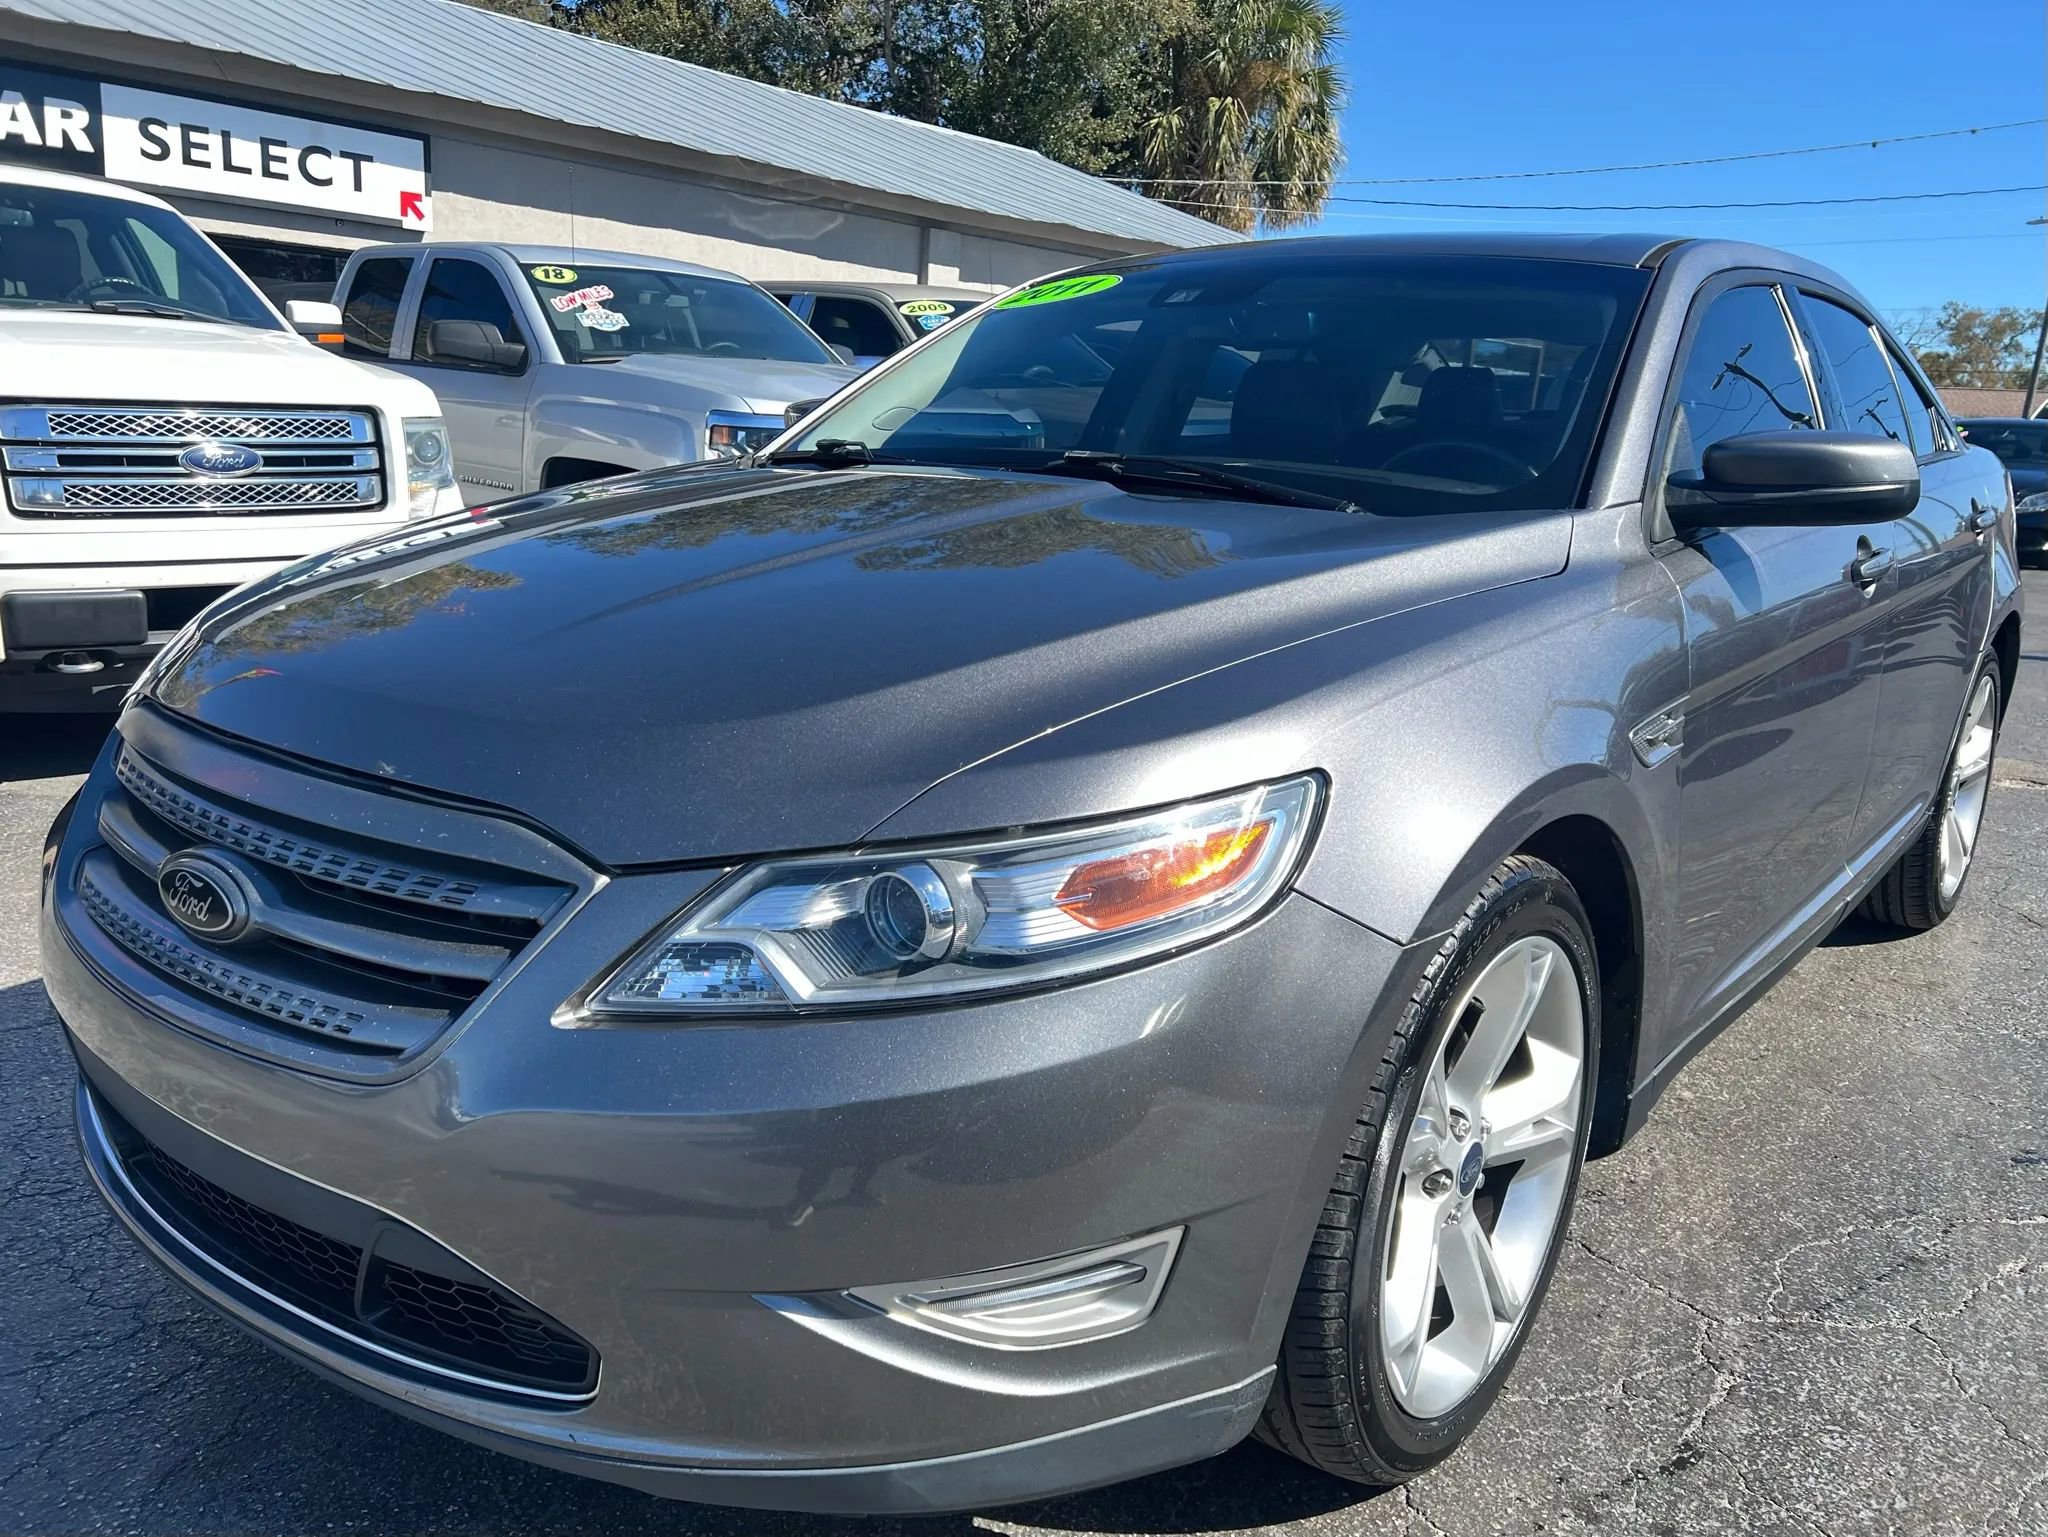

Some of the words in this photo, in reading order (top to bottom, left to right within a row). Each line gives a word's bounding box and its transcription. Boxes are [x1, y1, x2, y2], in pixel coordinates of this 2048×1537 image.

[138, 117, 374, 192] SELECT
[541, 267, 566, 280] 18
[553, 294, 578, 310] LOW
[577, 286, 612, 301] MILES
[1000, 278, 1111, 307] 2011
[907, 304, 948, 313] 2009
[169, 871, 213, 921] Ford
